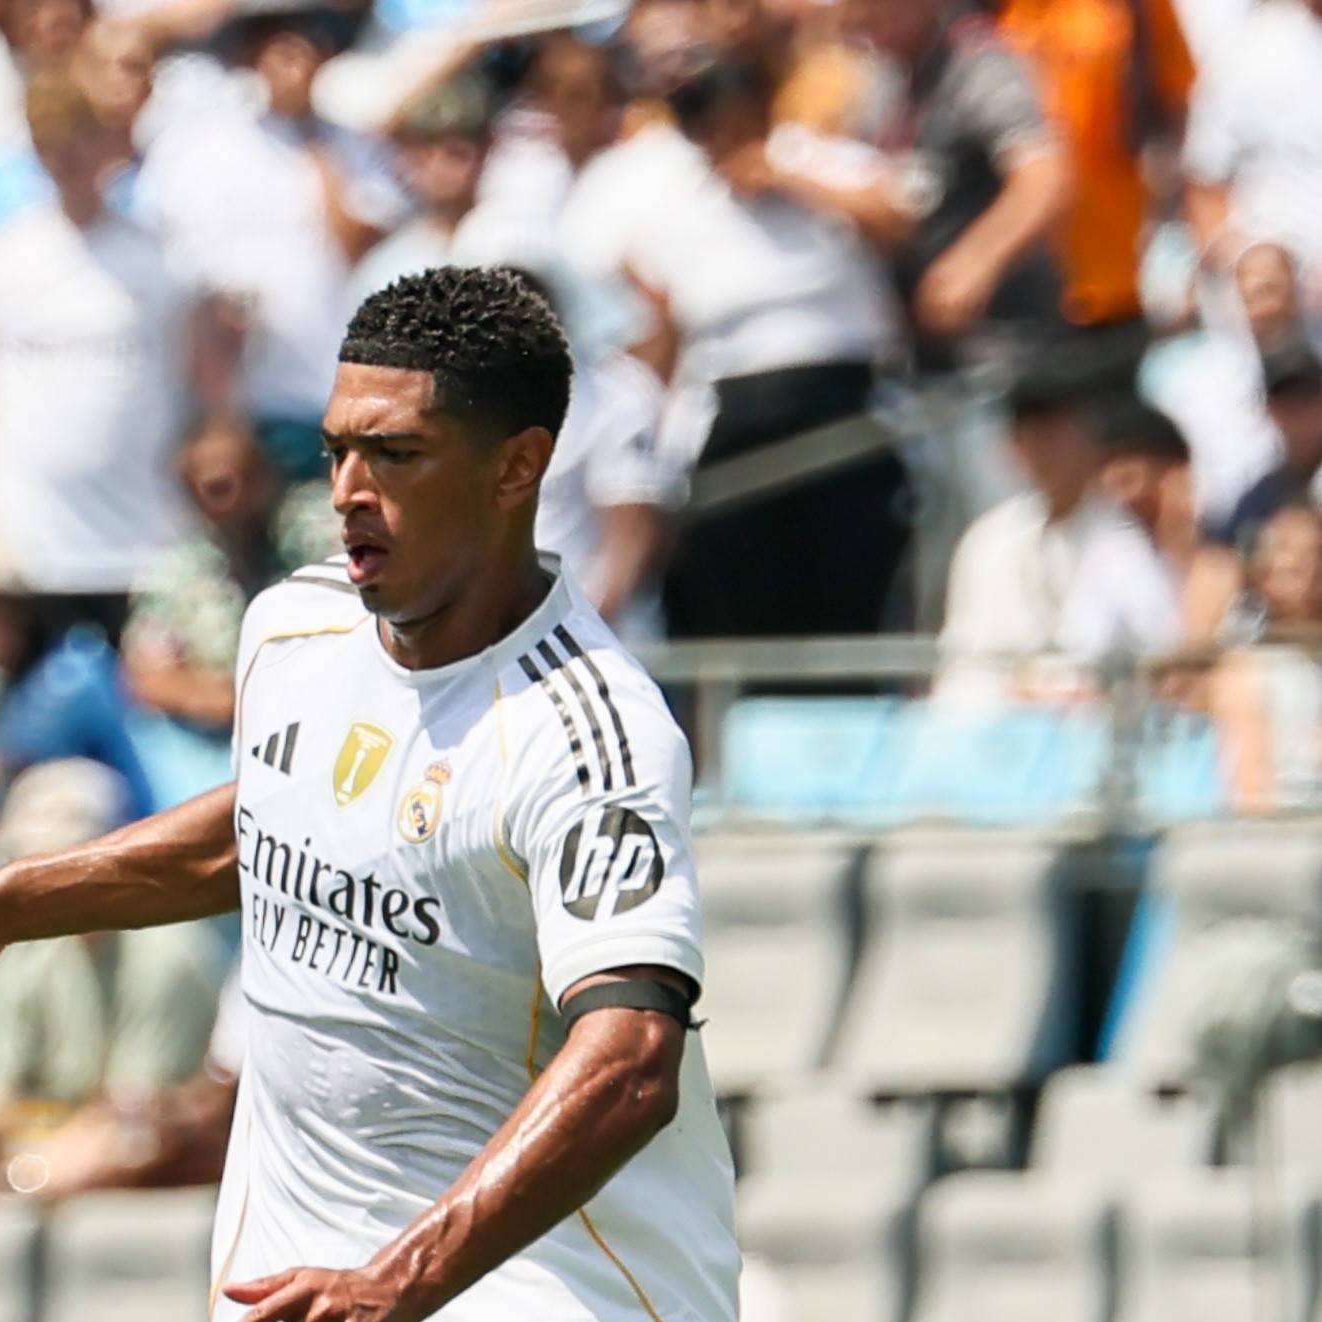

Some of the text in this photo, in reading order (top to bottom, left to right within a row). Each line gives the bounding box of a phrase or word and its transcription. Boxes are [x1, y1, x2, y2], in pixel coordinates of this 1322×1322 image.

[238, 806, 441, 946] Emirates
[559, 802, 664, 921] hp
[253, 894, 399, 994] FLY BETTER
